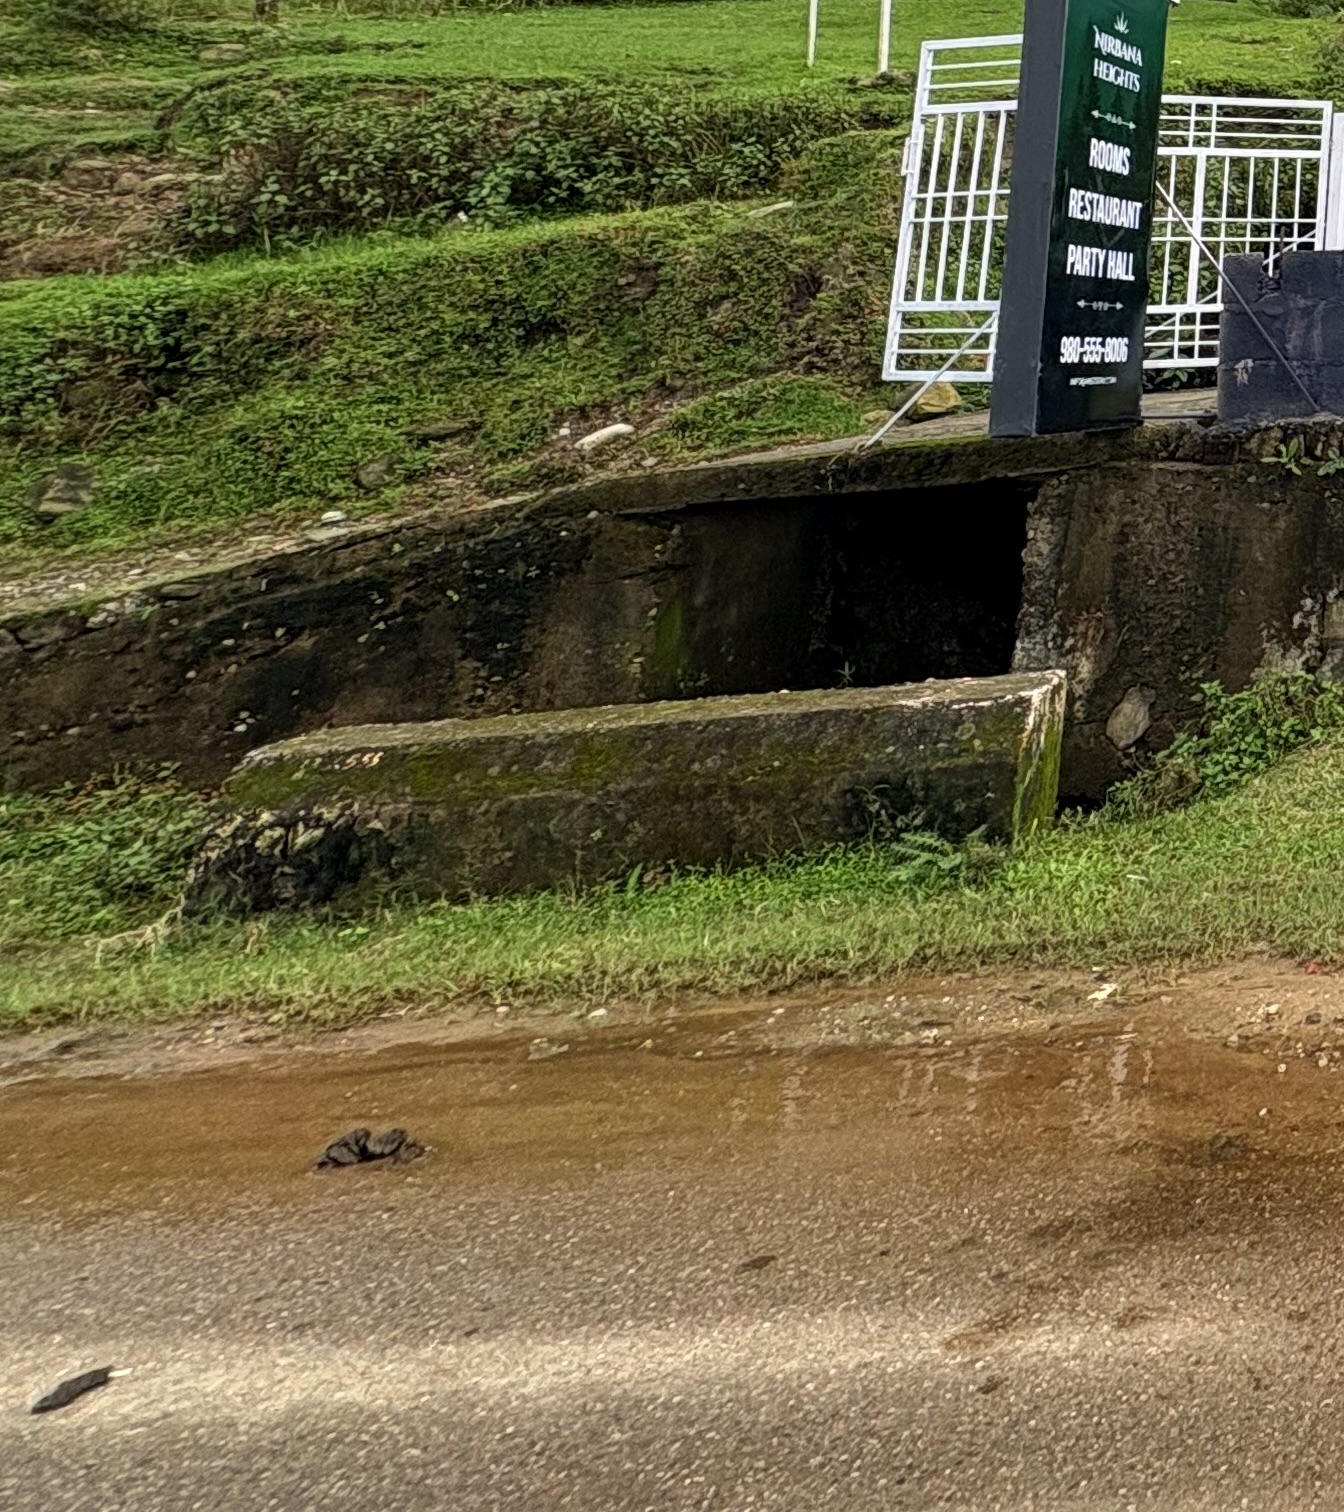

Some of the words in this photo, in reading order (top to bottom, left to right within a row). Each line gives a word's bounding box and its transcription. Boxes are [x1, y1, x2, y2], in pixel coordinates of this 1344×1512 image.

[1092, 24, 1143, 67] NIRBANA
[1093, 57, 1140, 93] HEIGHTS
[1088, 137, 1131, 176] ROOMS
[1067, 187, 1143, 230] RESTAURANT
[1066, 243, 1107, 278] PARTY
[1106, 248, 1136, 281] HALL
[1059, 335, 1129, 364] 980-555-8006
